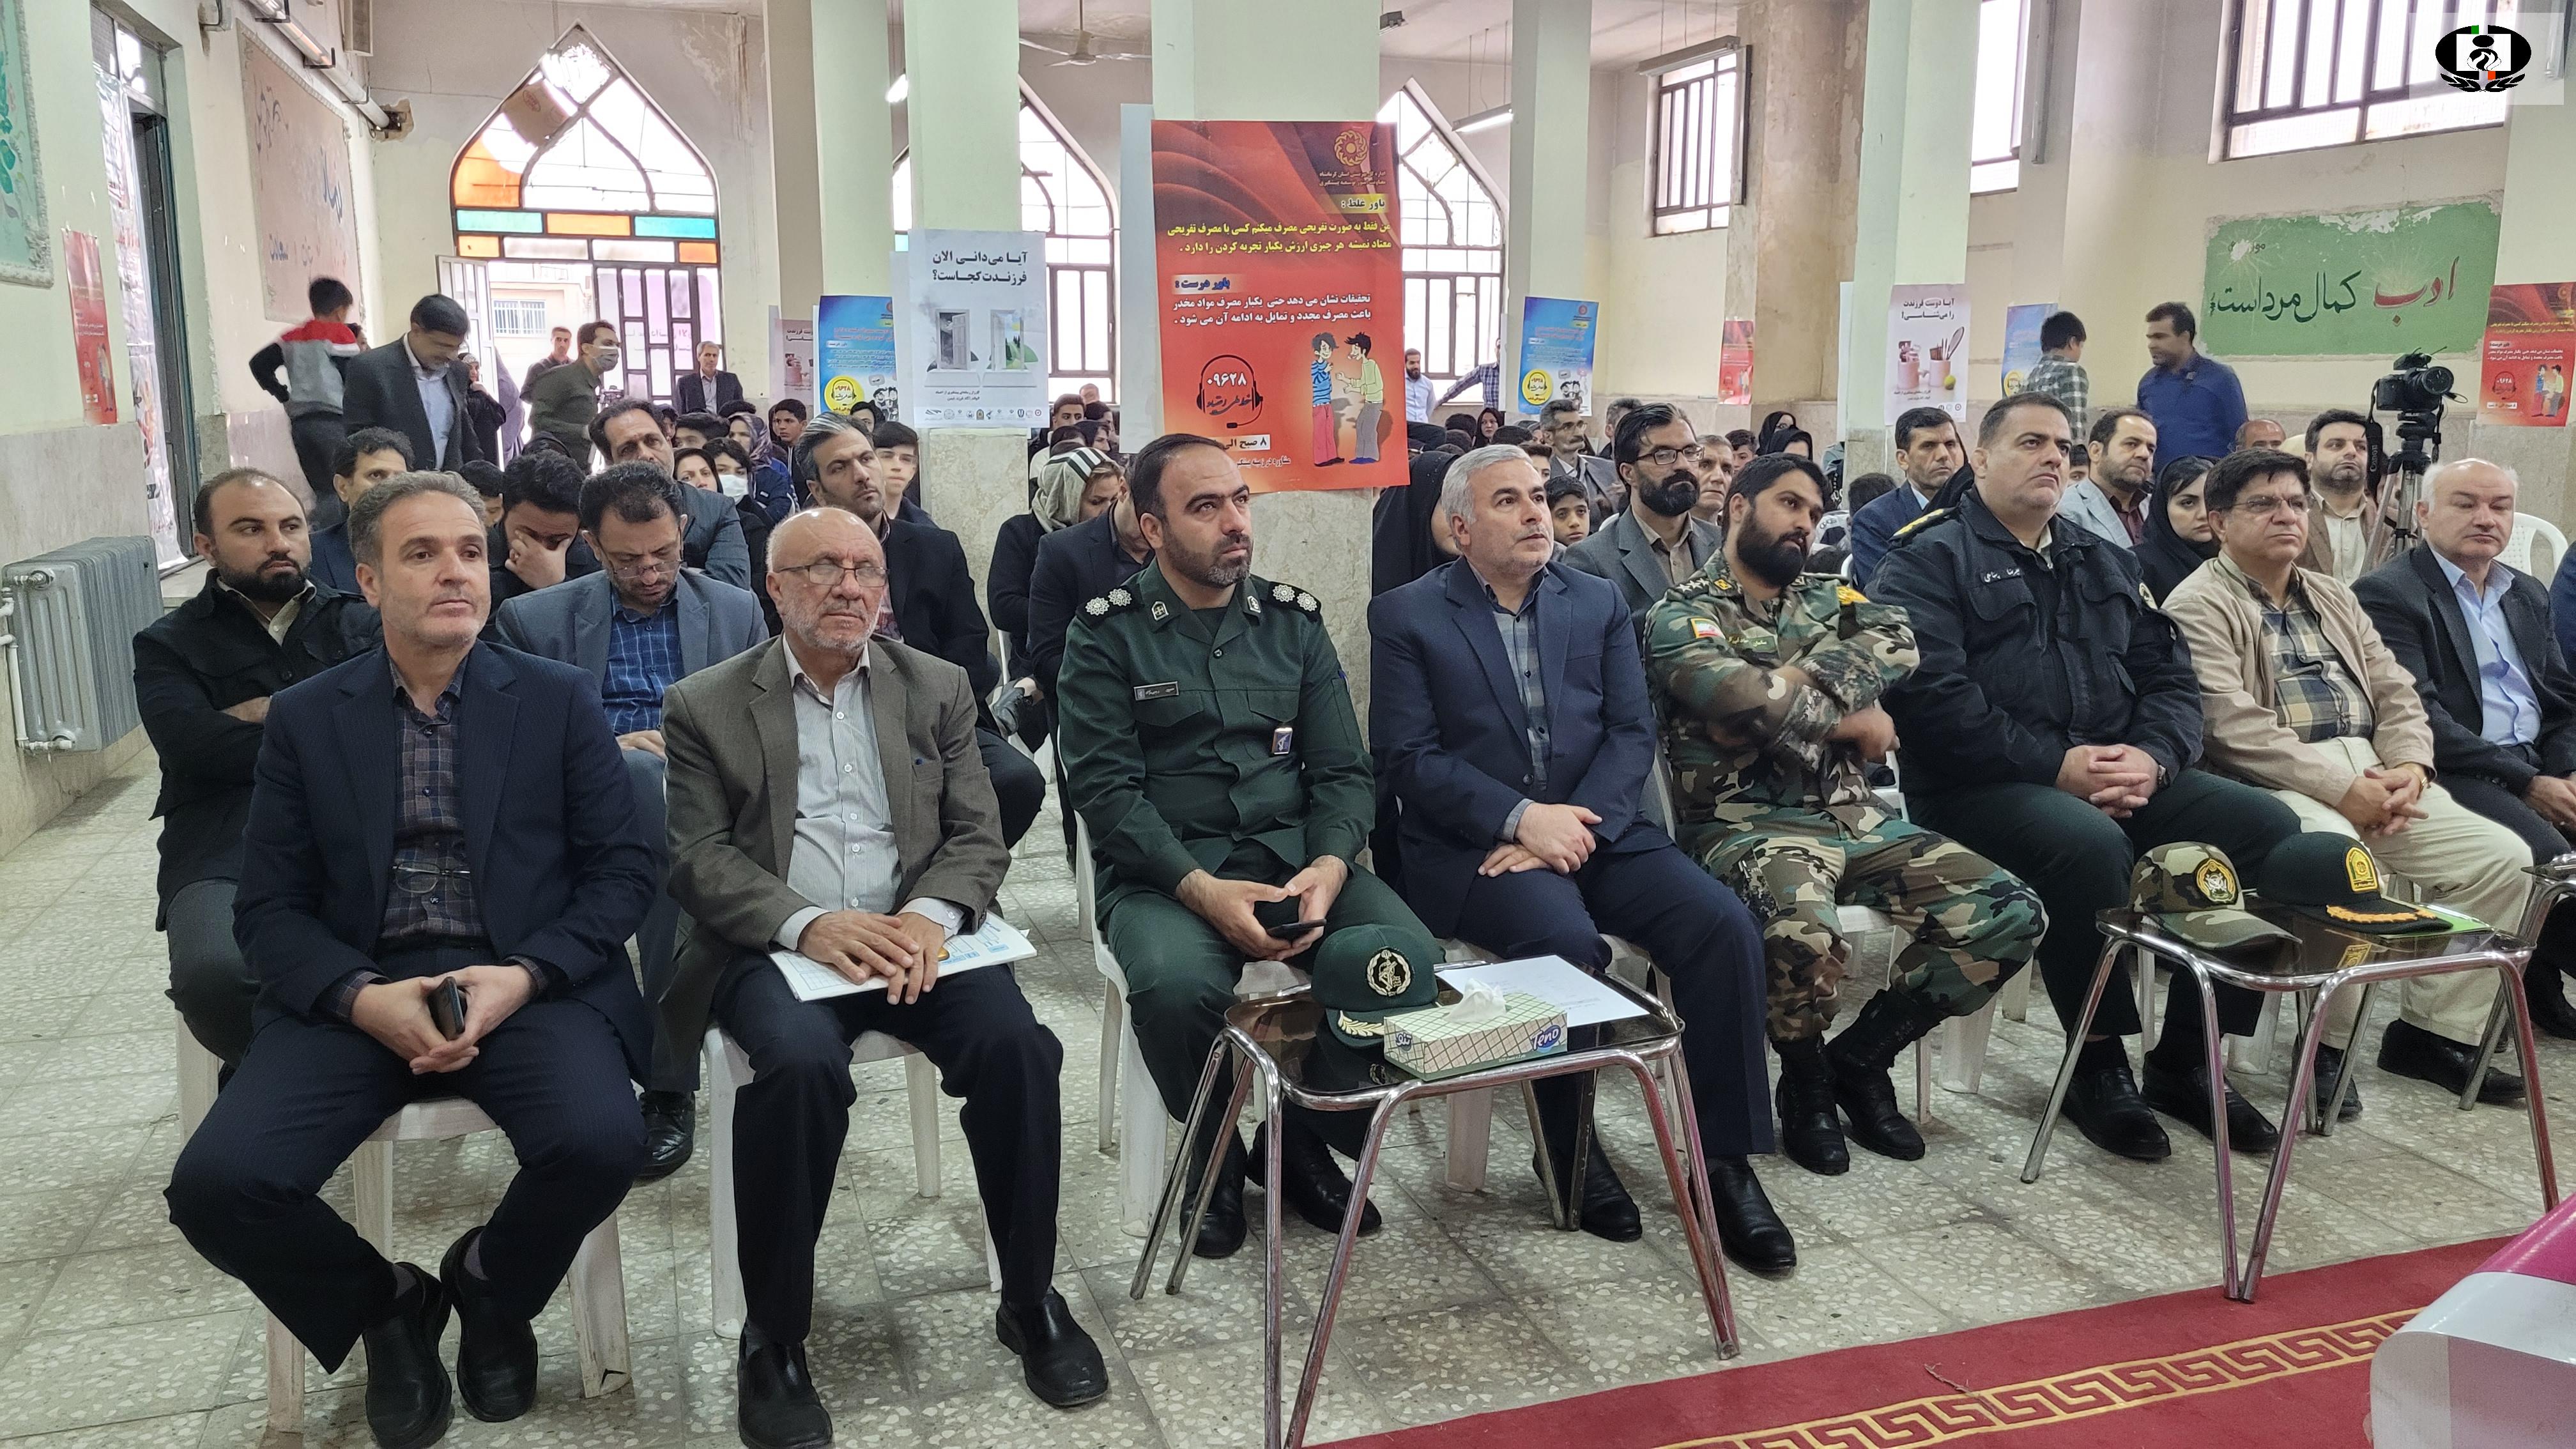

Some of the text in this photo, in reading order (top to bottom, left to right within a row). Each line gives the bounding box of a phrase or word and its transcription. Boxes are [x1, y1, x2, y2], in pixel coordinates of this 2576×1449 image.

[1348, 198, 1365, 208] غلط
[1368, 199, 1385, 210] باور
[1167, 221, 1391, 236] من فقط به صورت تفریحی مصرف میکنم کسی با مصرف تفریحی
[1206, 242, 1213, 254] را
[1215, 241, 1238, 254] کردن
[1239, 241, 1262, 253] تجربه
[1264, 241, 1283, 253] یکبار
[1285, 240, 1308, 252] ارزش
[1310, 242, 1332, 253] چیزی
[1334, 241, 1344, 252] هر
[1348, 240, 1370, 250] نمیشه
[1371, 239, 1392, 248] معتاد
[933, 250, 952, 264] الان
[1006, 251, 1027, 266] آیا
[932, 269, 1027, 286] فرزندت کجاست؟
[1181, 279, 1210, 291] درست
[1212, 277, 1230, 291] باور
[2293, 270, 2363, 323] کمال
[2373, 256, 2460, 327] ادب
[1173, 294, 1370, 310] تحقیقات نشان می دهد حتی یکبار مصرف مواد مخدر
[1903, 299, 1924, 309] فرزندت
[1943, 298, 1954, 308] آیا
[1180, 314, 1197, 326] شود
[1200, 316, 1213, 325] می
[1215, 312, 1229, 325] آن
[1230, 312, 1253, 322] ادامه
[1255, 313, 1263, 323] به
[1265, 311, 1287, 323] تمایل
[1289, 314, 1294, 323] و
[1297, 312, 1321, 321] مجدد
[1322, 309, 1349, 322] مصرف
[1351, 309, 1371, 320] باعث
[1949, 310, 1954, 319] را
[1207, 372, 1246, 387] ۰۹۶۲۸
[1239, 440, 1257, 448] صبح
[1260, 436, 1267, 446] ۸
[1397, 1033, 1412, 1046] تنو
[1532, 1028, 1560, 1050] Teno
